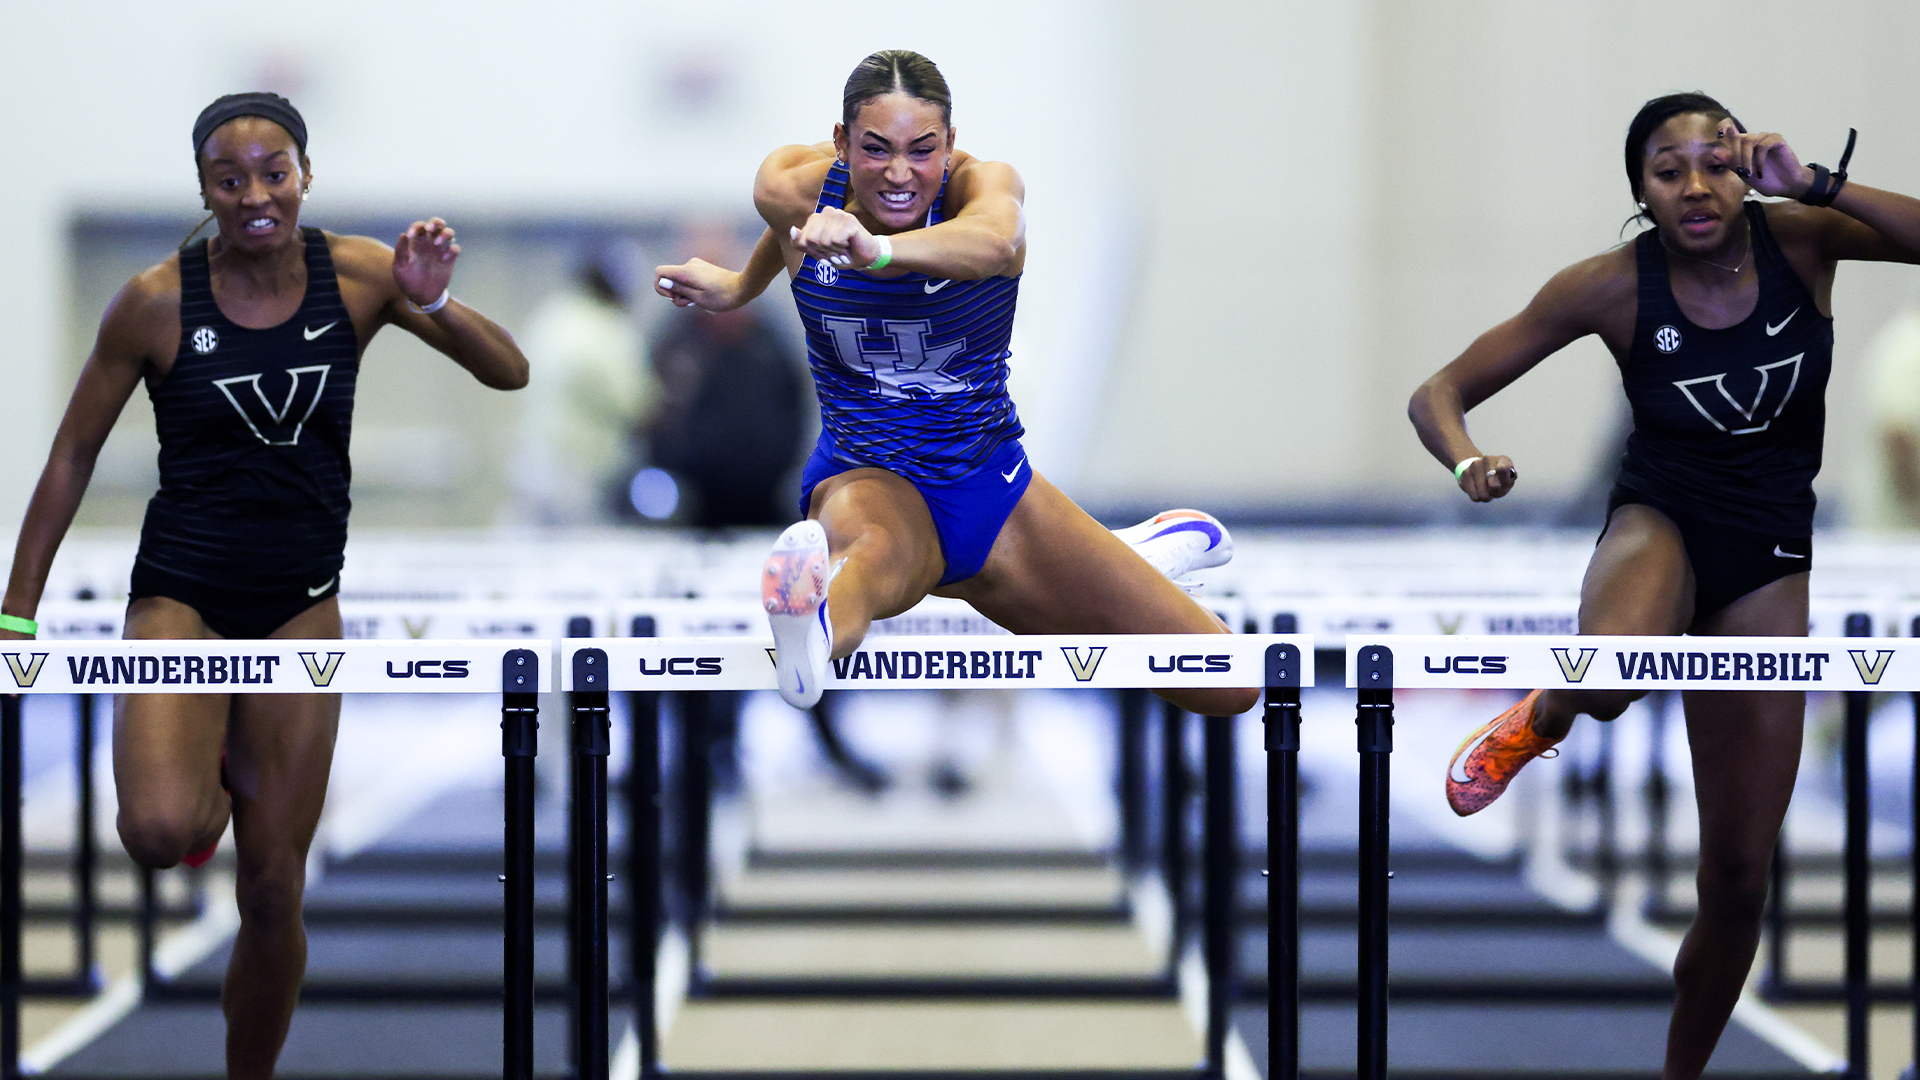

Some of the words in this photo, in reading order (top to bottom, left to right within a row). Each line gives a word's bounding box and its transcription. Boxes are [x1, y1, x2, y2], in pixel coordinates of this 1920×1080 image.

[816, 262, 837, 284] SEC
[193, 328, 217, 352] SEC
[1656, 327, 1680, 352] SEC
[212, 364, 332, 446] V
[1672, 352, 1805, 436] V
[2, 653, 49, 688] V
[67, 656, 280, 684] VANDERBILT
[297, 652, 346, 687] V
[386, 660, 471, 678] UCS
[639, 657, 724, 676] UCS
[832, 651, 1042, 680] VANDERBILT
[1060, 646, 1108, 681] V
[1149, 655, 1233, 673] UCS
[1424, 656, 1509, 674] UCS
[1550, 648, 1599, 683] V
[1616, 652, 1830, 681] VANDERBILT
[1847, 650, 1895, 685] V
